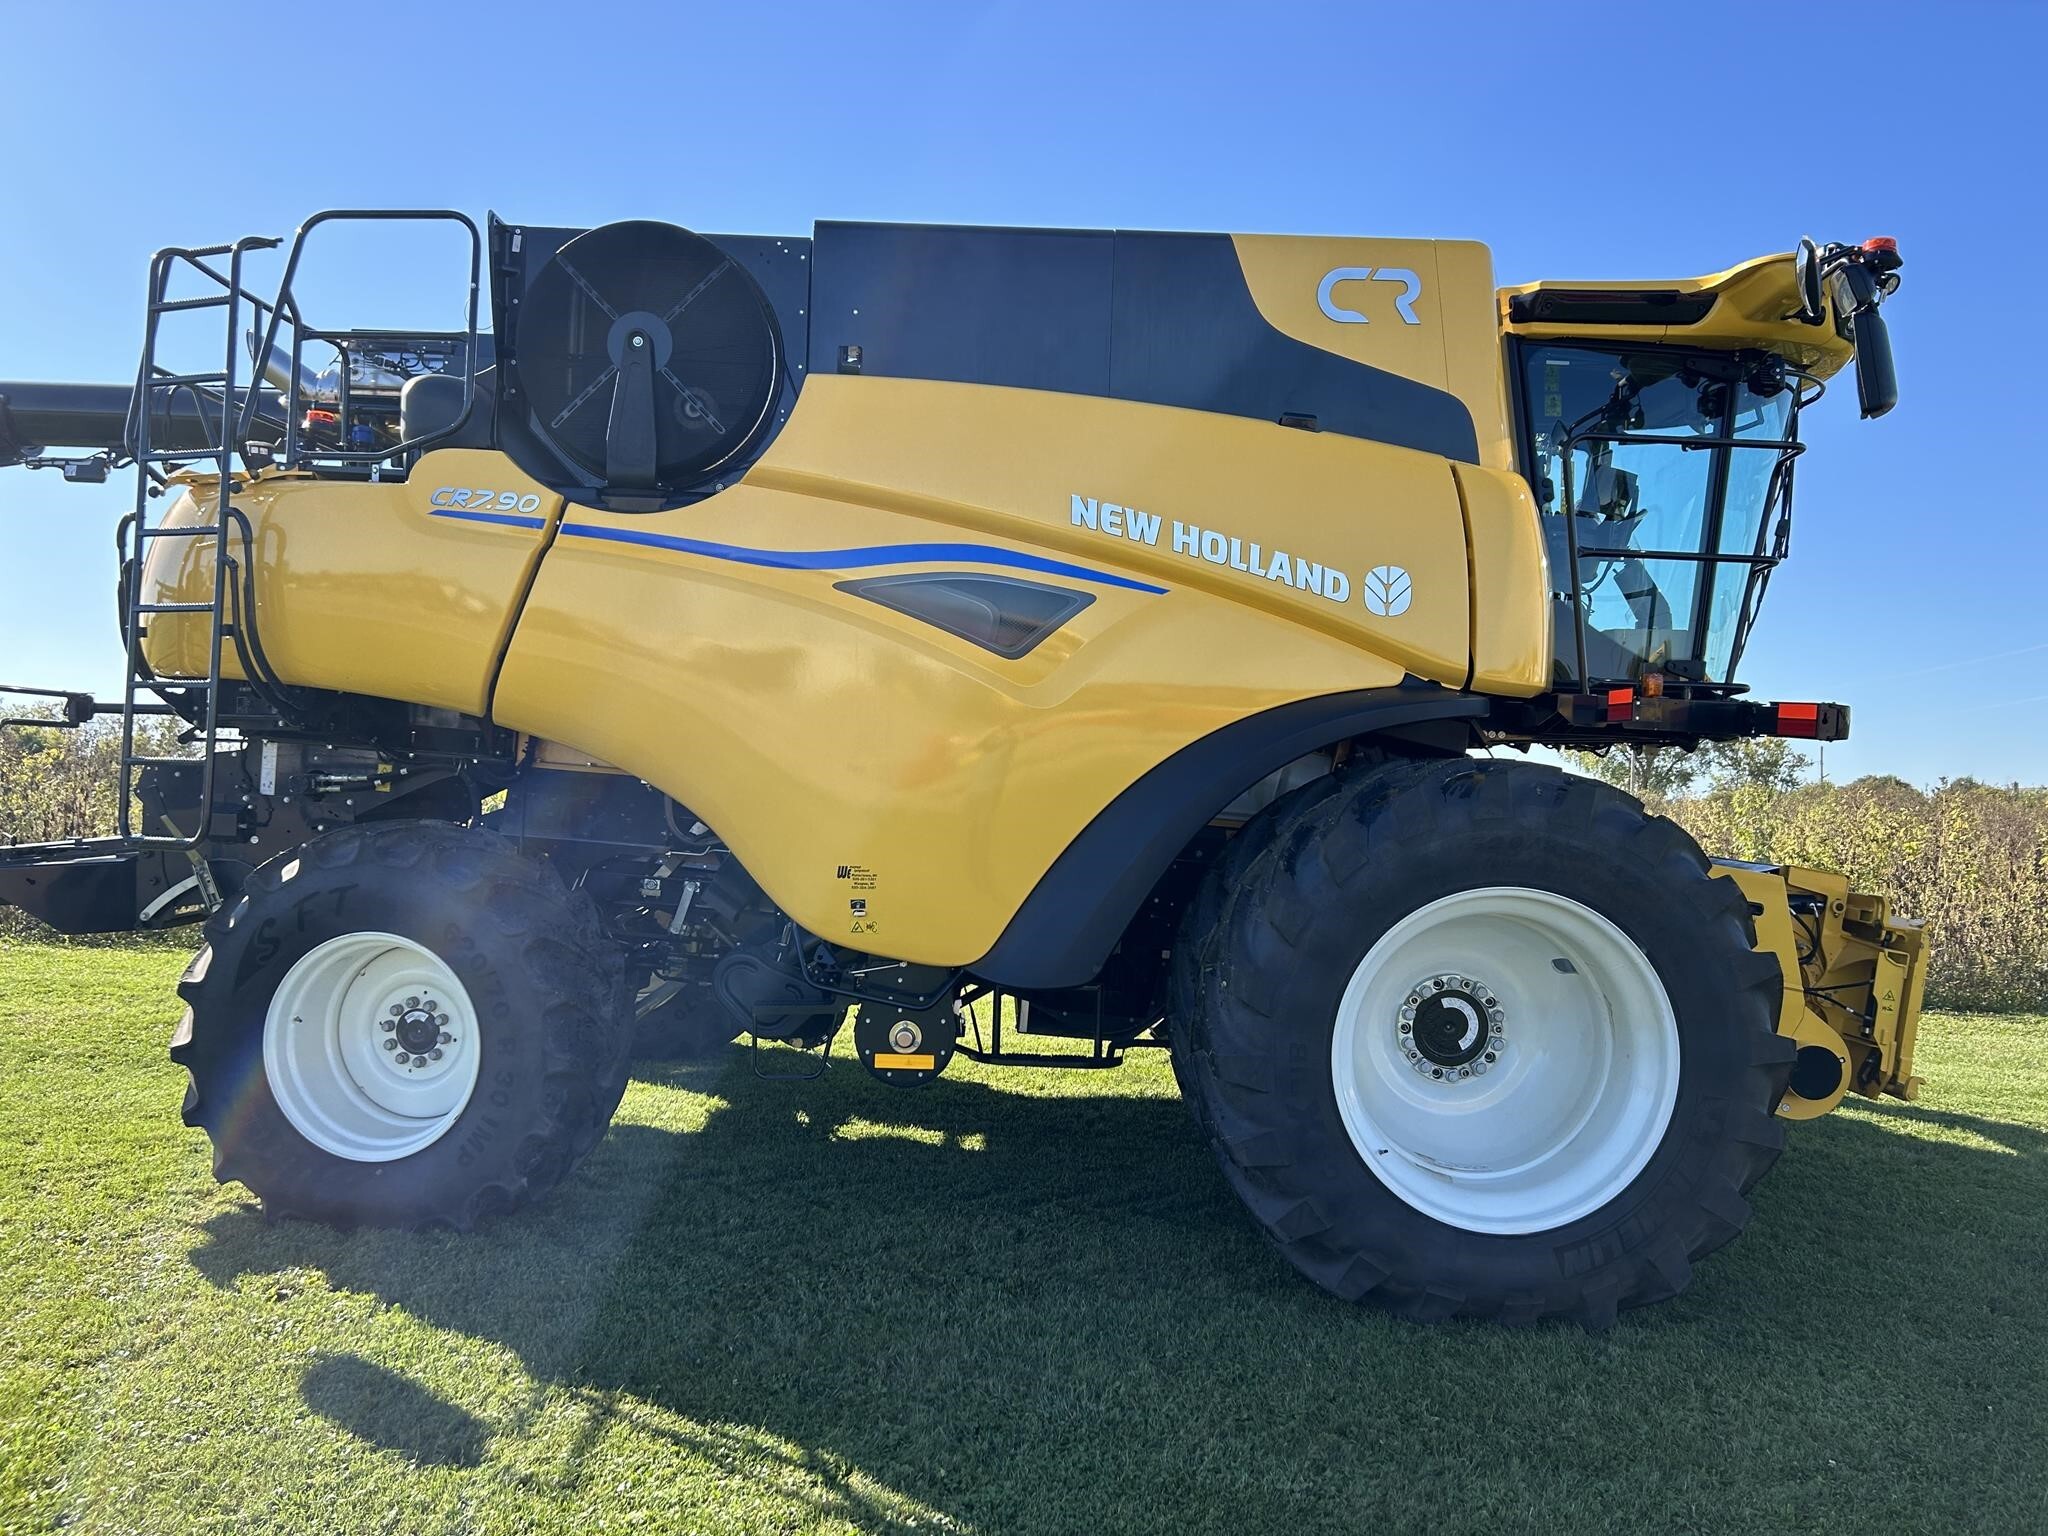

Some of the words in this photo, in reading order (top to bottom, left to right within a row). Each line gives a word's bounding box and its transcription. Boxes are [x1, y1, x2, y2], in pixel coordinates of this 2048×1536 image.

[1316, 266, 1421, 325] CR
[430, 486, 541, 514] CR7.90
[1070, 494, 1162, 547] NEW
[1172, 520, 1351, 603] HOLLAND
